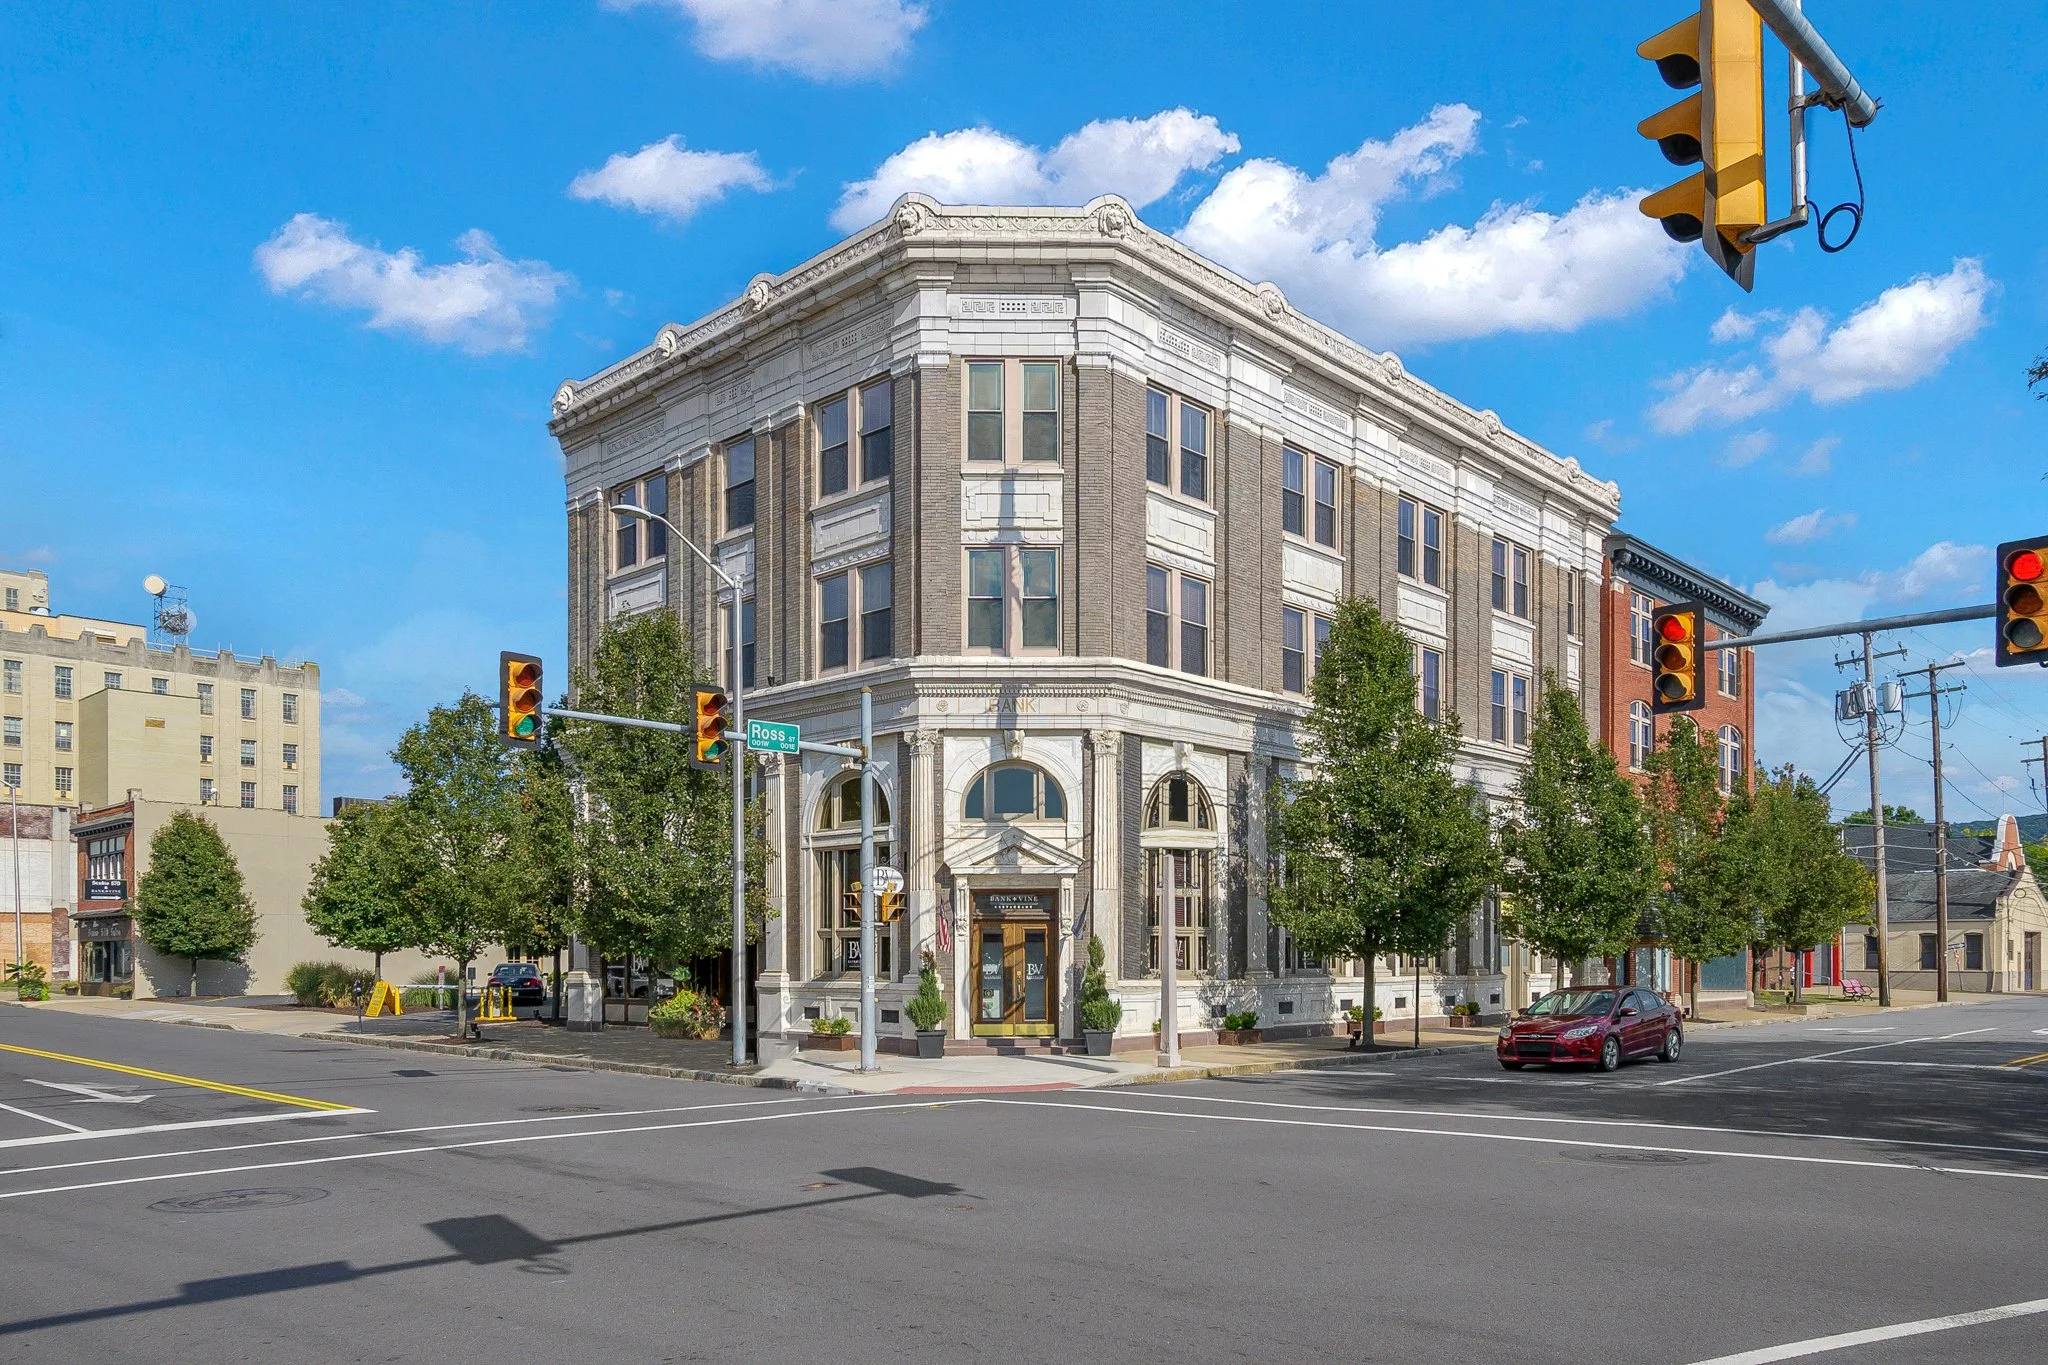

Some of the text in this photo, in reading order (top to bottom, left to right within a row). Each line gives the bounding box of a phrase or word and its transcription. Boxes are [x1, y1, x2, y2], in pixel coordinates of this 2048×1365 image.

[988, 698, 1037, 713] BANK
[751, 723, 786, 742] Ross
[751, 739, 796, 750] 001W 001E
[1026, 963, 1043, 975] BV
